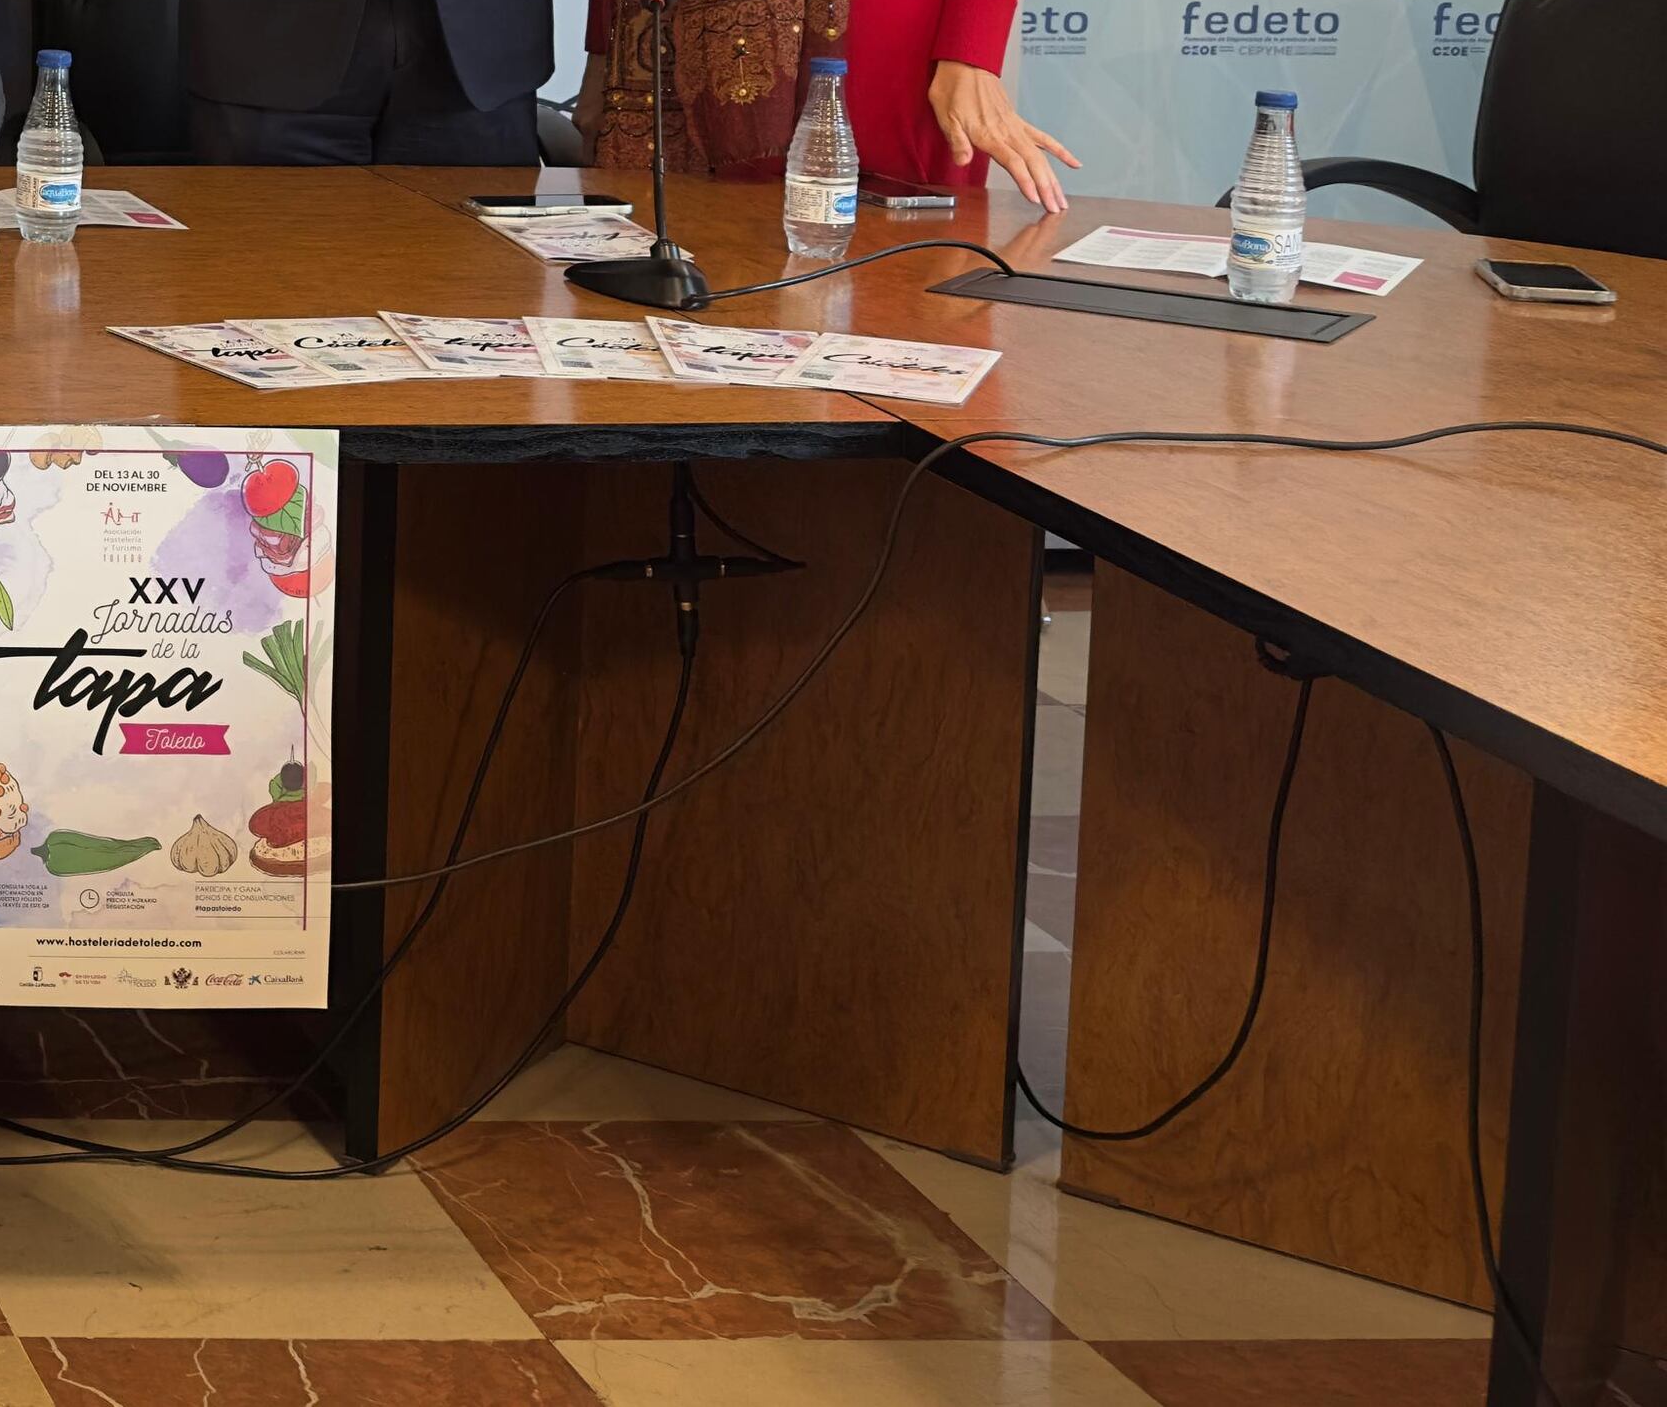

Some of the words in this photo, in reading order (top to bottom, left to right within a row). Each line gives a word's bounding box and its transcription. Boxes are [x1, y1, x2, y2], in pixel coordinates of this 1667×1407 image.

[1182, 1, 1339, 35] fedeto
[94, 470, 114, 479] DEL
[117, 470, 129, 479] 13
[131, 470, 145, 479] AL
[147, 470, 160, 479] 30
[86, 483, 100, 492] DE
[102, 483, 167, 493] NOVIEMBRE
[128, 577, 205, 604] XXV
[91, 599, 233, 644] Jornadas
[151, 638, 175, 659] de
[180, 638, 200, 659] la
[146, 728, 205, 751] Toledo
[36, 936, 202, 948] www.hosteleriadetoledo.com
[263, 975, 304, 984] CaixaBank
